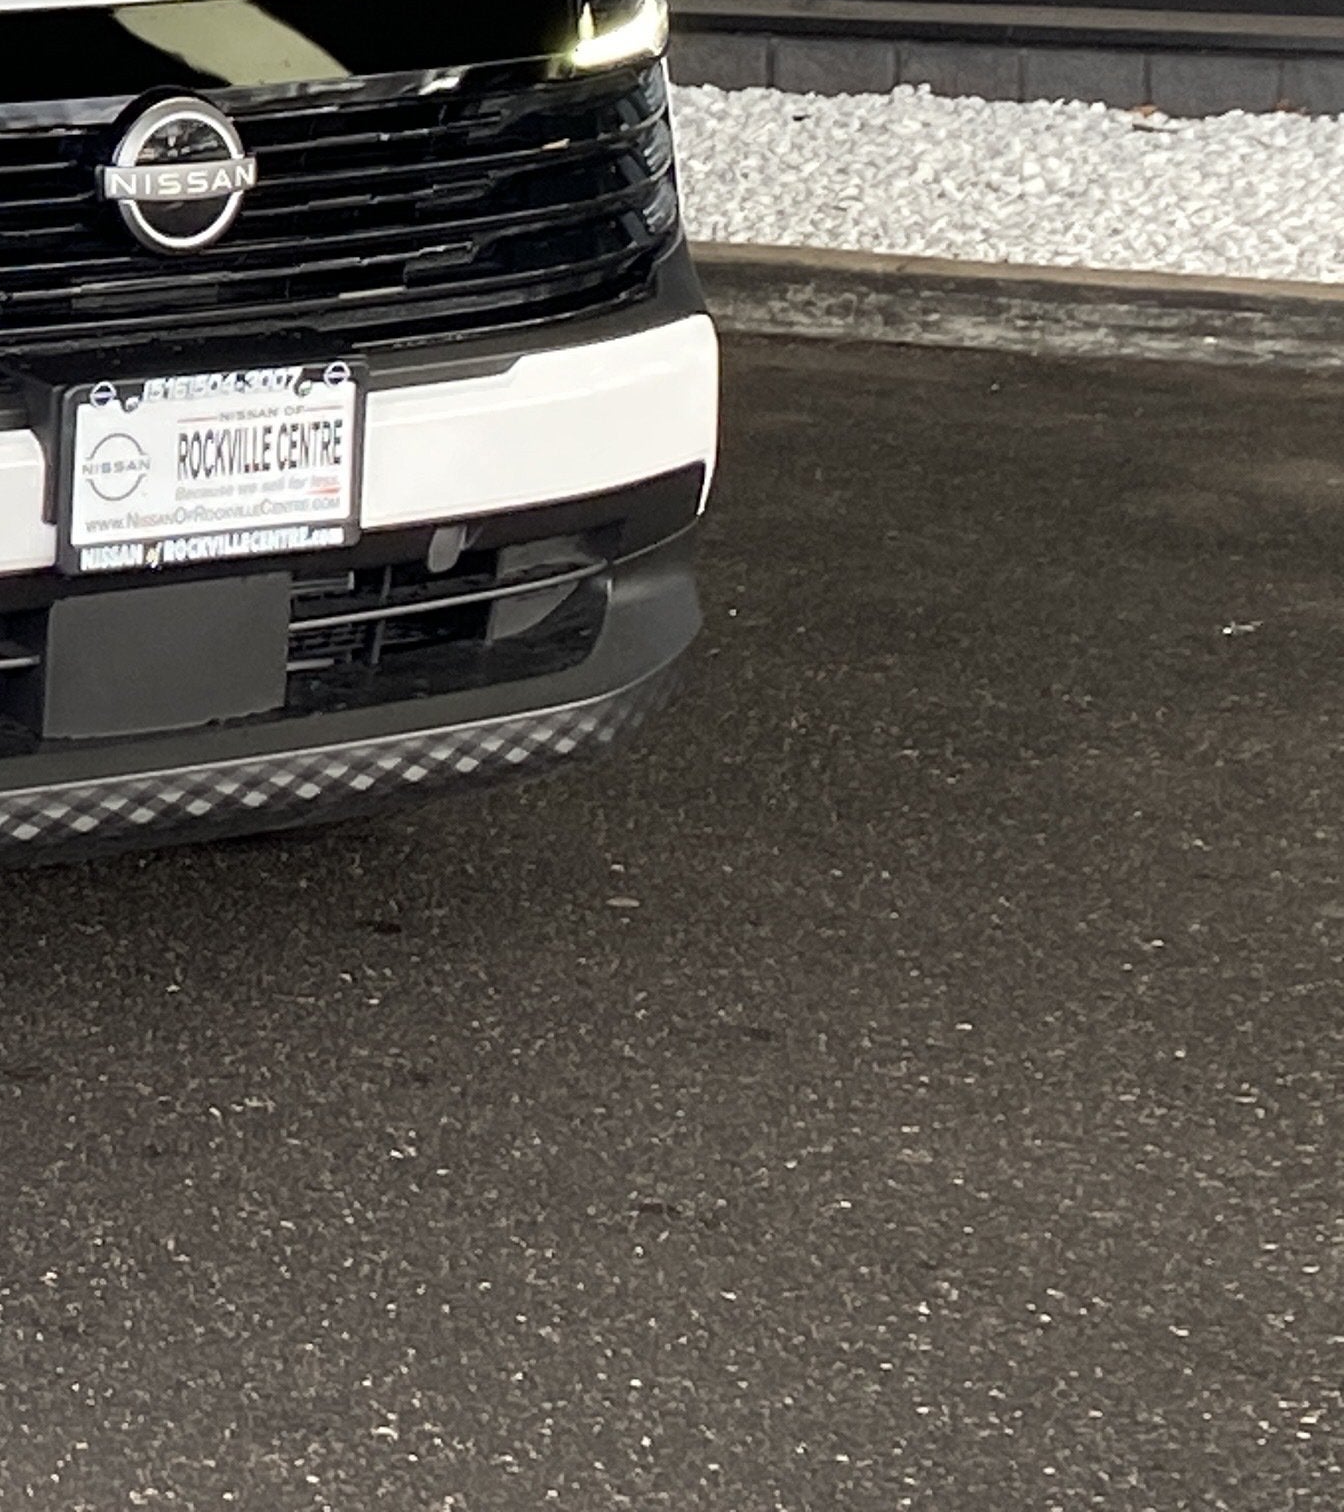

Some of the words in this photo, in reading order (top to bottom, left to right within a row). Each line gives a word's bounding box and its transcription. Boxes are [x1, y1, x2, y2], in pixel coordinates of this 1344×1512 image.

[111, 163, 254, 196] NISSAN
[177, 424, 272, 481] ROCKVILLE
[276, 419, 343, 472] CENTRE
[82, 459, 151, 475] NISSAN
[80, 543, 144, 571] NISSAN
